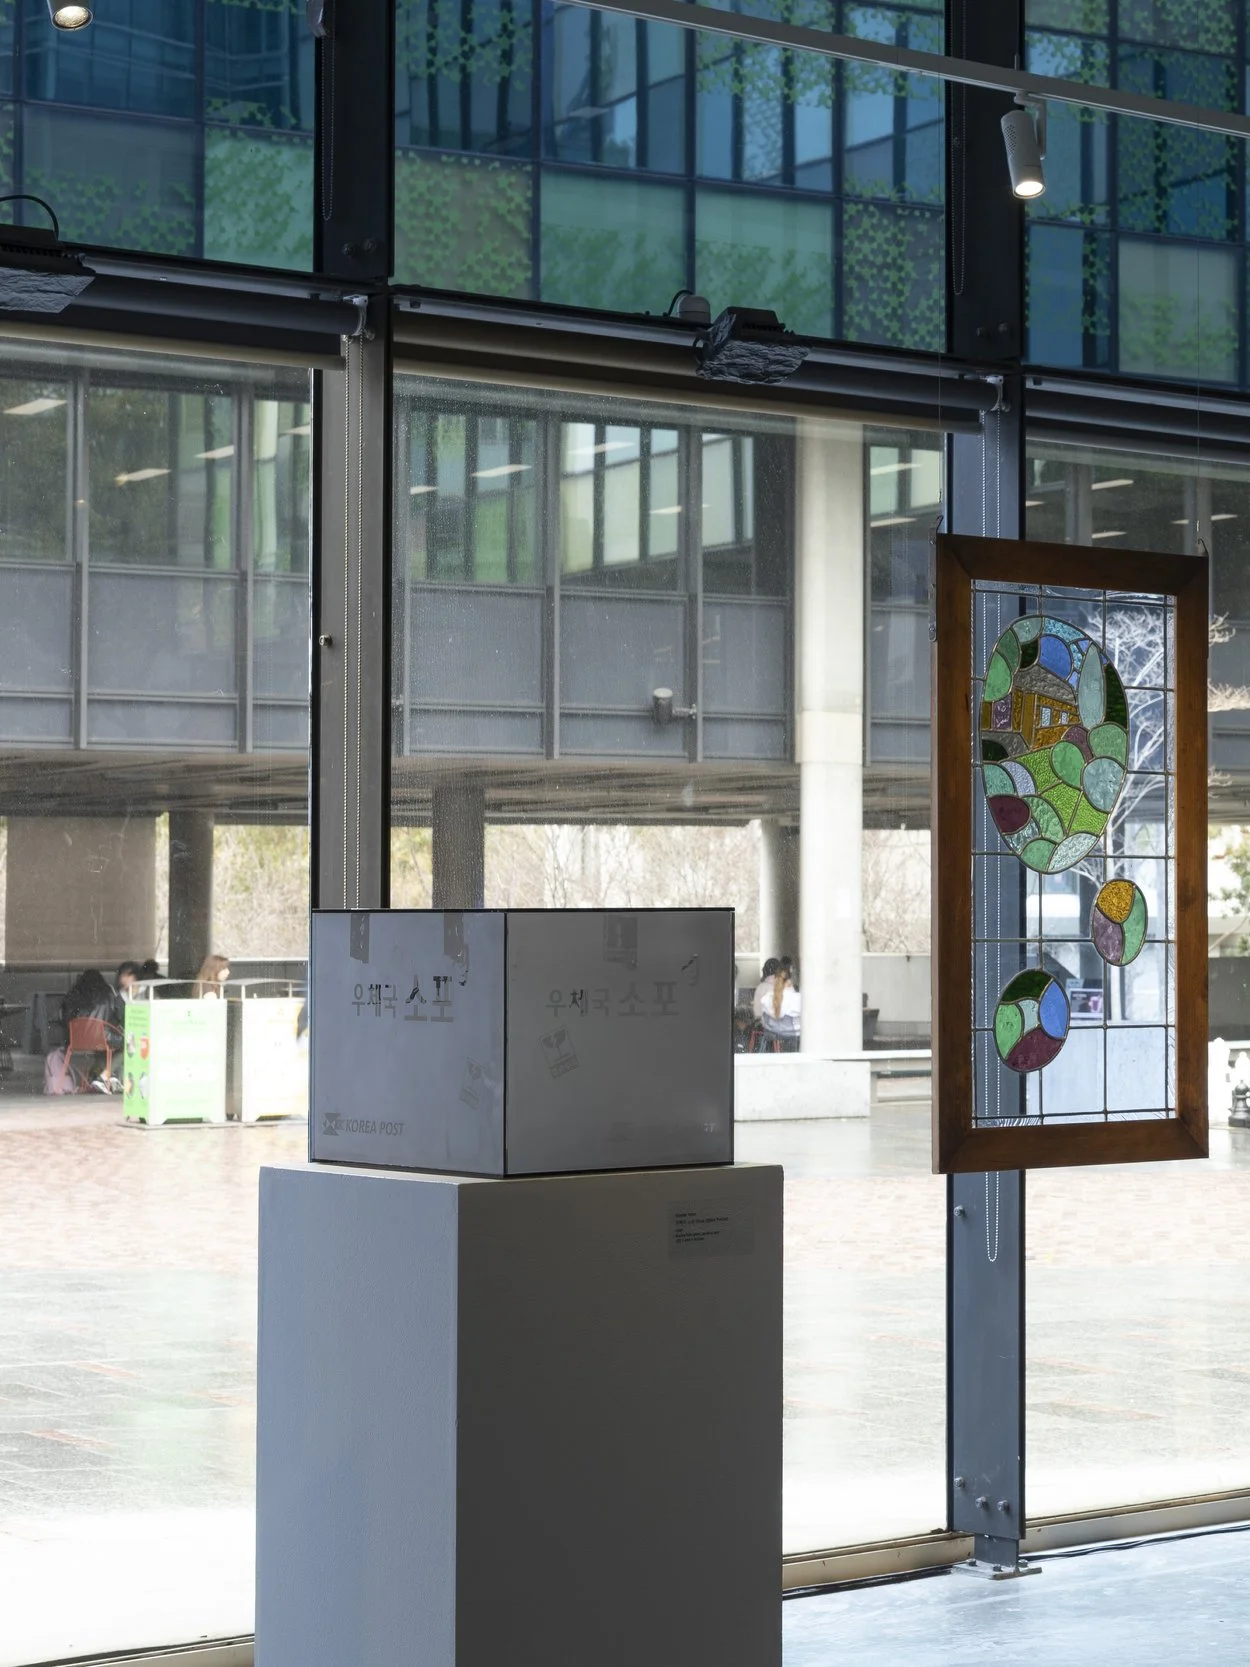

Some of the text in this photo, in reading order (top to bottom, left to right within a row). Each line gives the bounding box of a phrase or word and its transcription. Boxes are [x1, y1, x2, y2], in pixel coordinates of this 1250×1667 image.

[351, 974, 454, 1022] 우체국 소포
[545, 981, 679, 1018] 우체국 소포
[345, 1119, 406, 1136] KOREA POST
